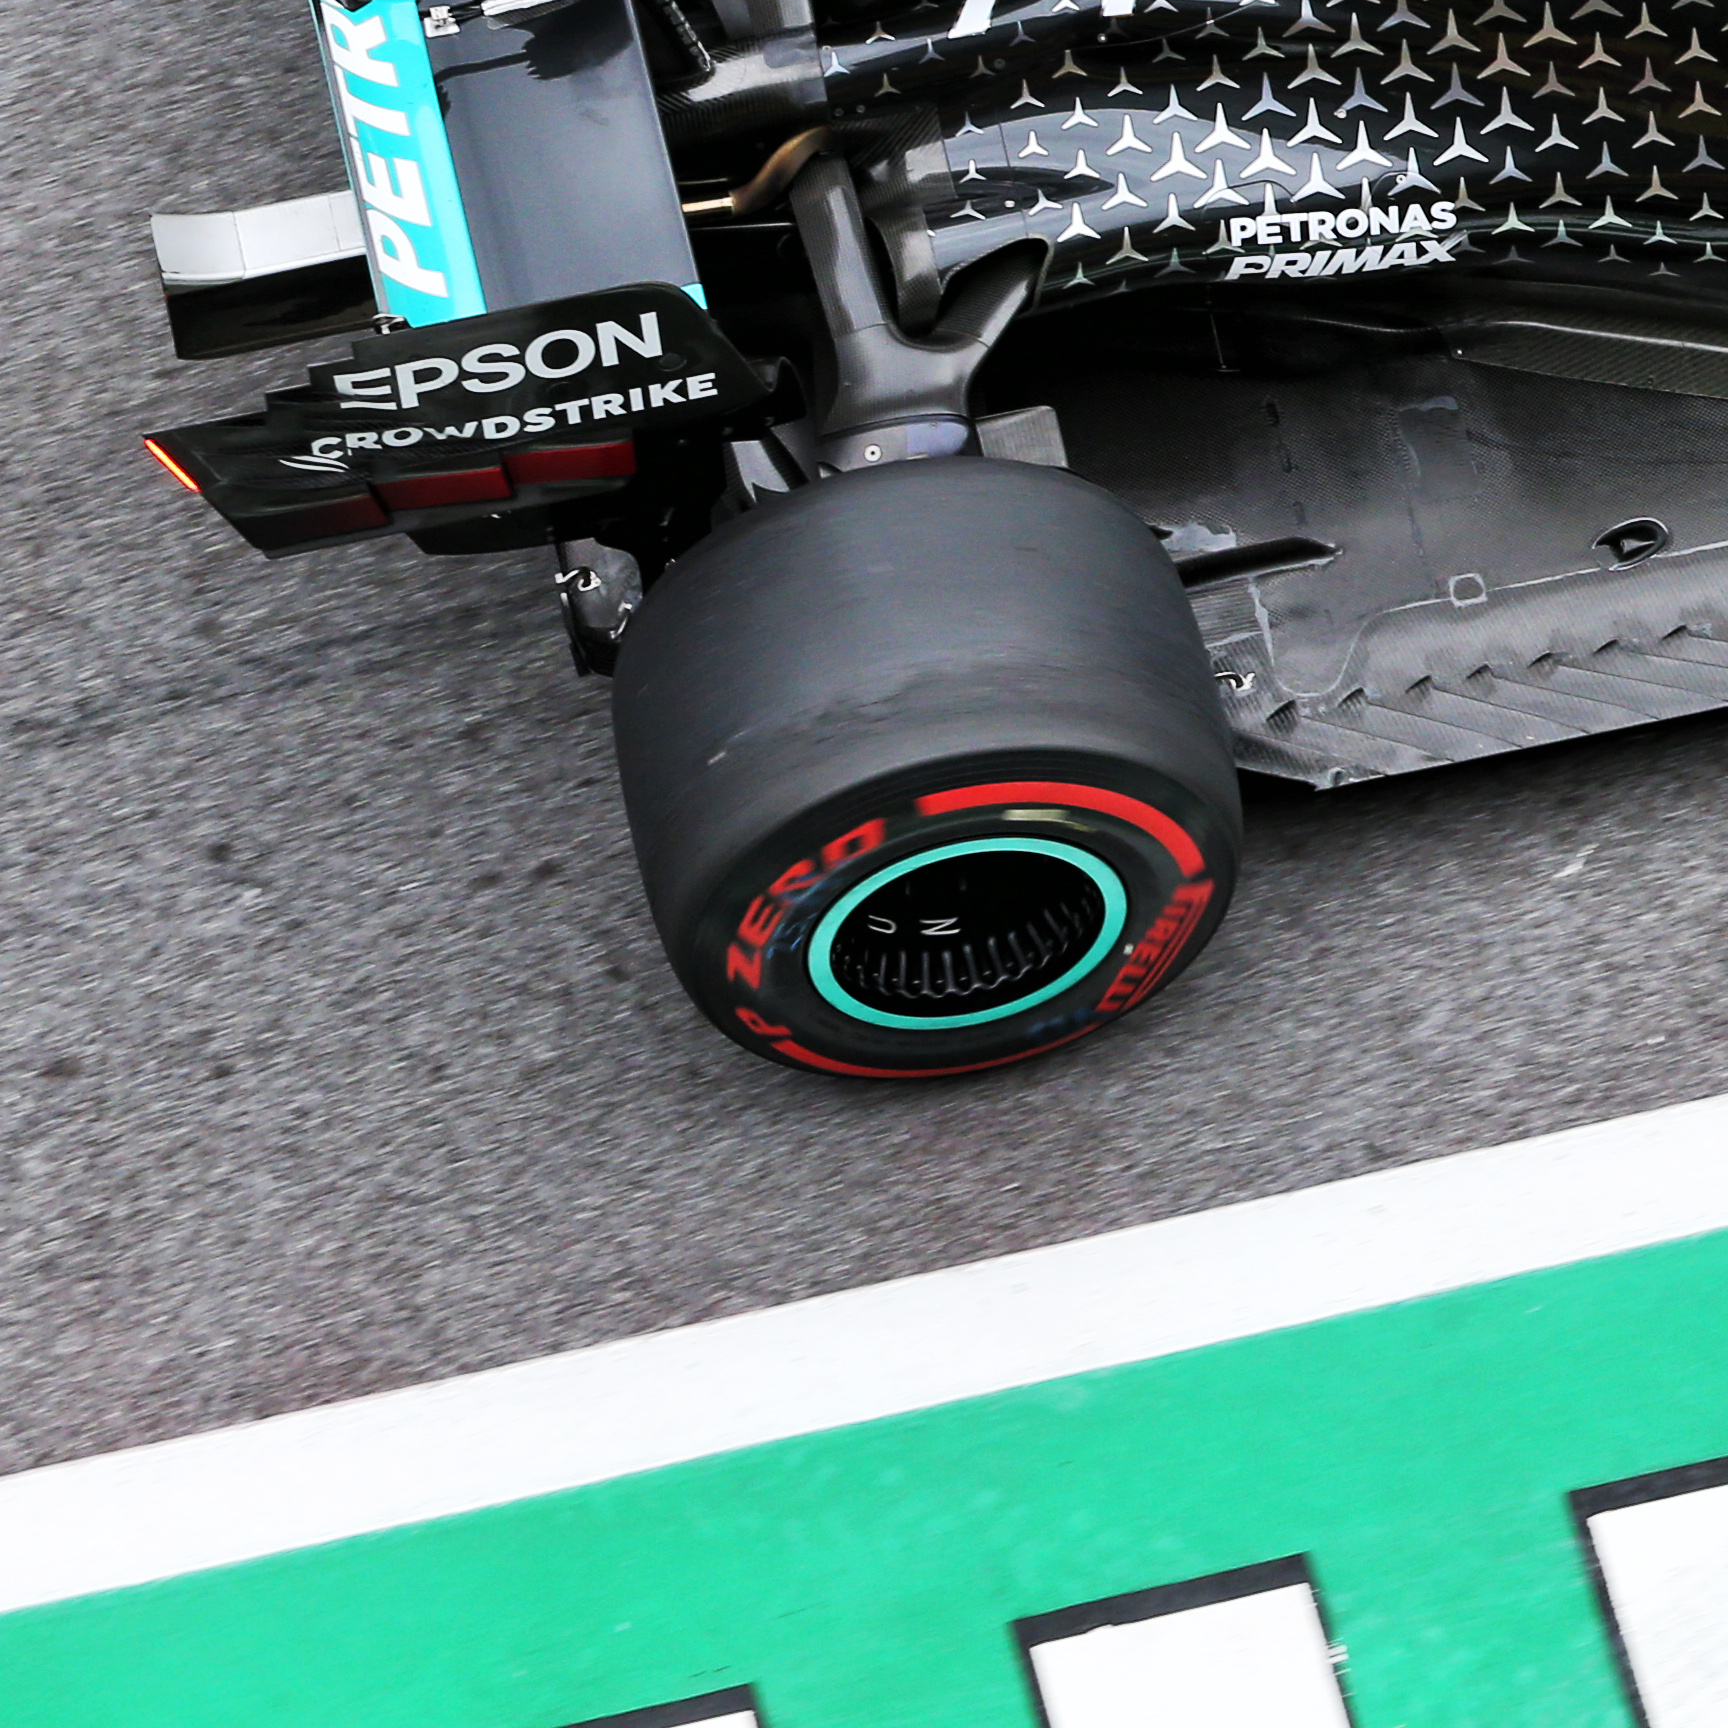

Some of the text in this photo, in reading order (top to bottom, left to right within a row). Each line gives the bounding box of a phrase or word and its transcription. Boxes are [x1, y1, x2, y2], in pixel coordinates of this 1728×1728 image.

[1224, 229, 1467, 281] PRIMAX
[1230, 201, 1457, 247] PETRONAS
[333, 310, 664, 412] EPSON
[309, 372, 719, 460] CROWDSTRIKE
[726, 817, 887, 1041] P ZERO
